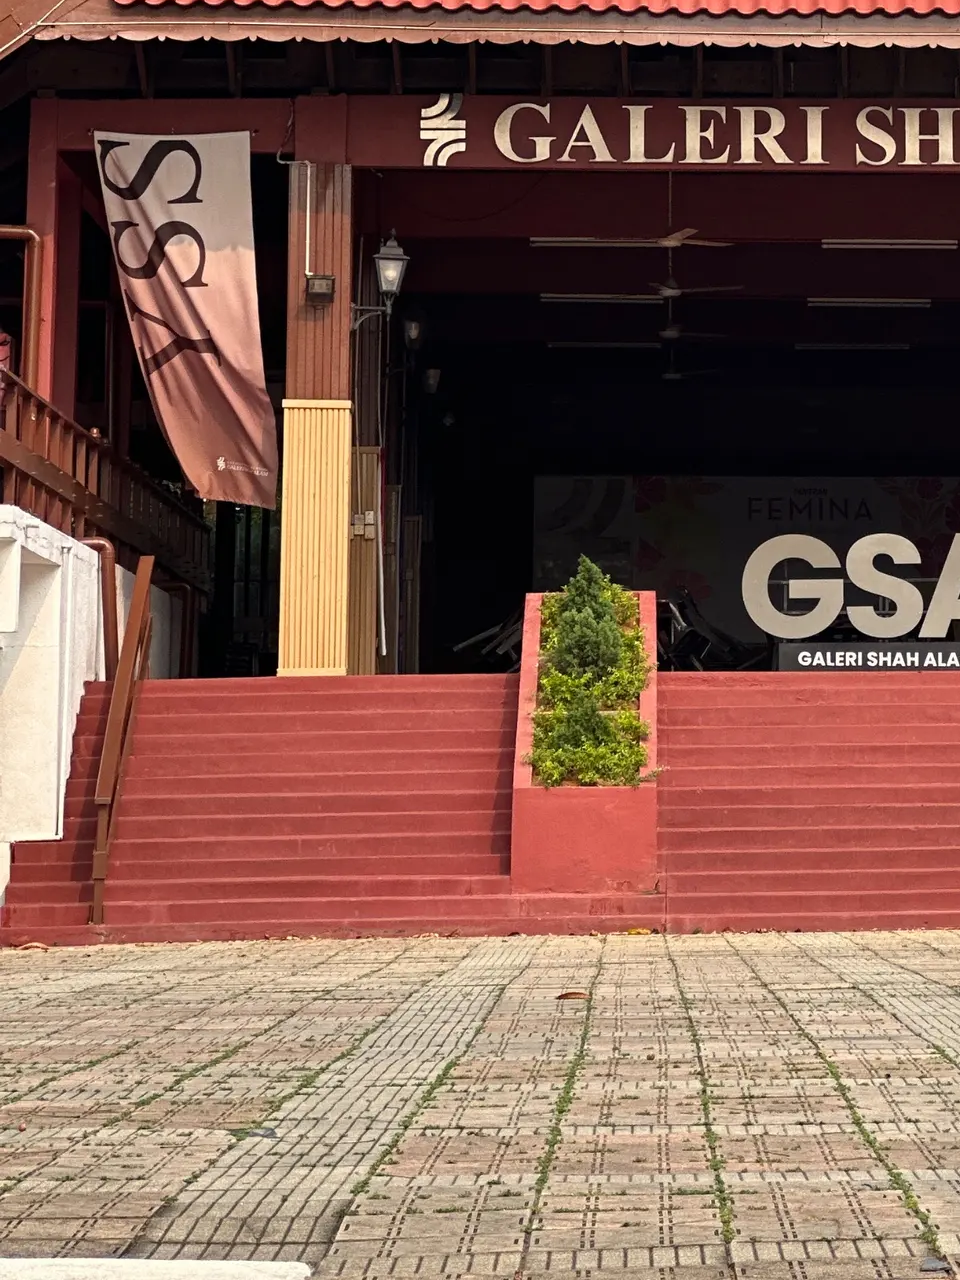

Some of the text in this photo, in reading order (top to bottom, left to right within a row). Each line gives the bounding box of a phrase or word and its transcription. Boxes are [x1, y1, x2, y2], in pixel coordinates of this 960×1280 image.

[493, 103, 830, 165] GALERI
[96, 139, 222, 377] YSS
[747, 497, 873, 521] FEMINA
[797, 651, 863, 667] GALERI
[866, 651, 920, 667] SHAH
